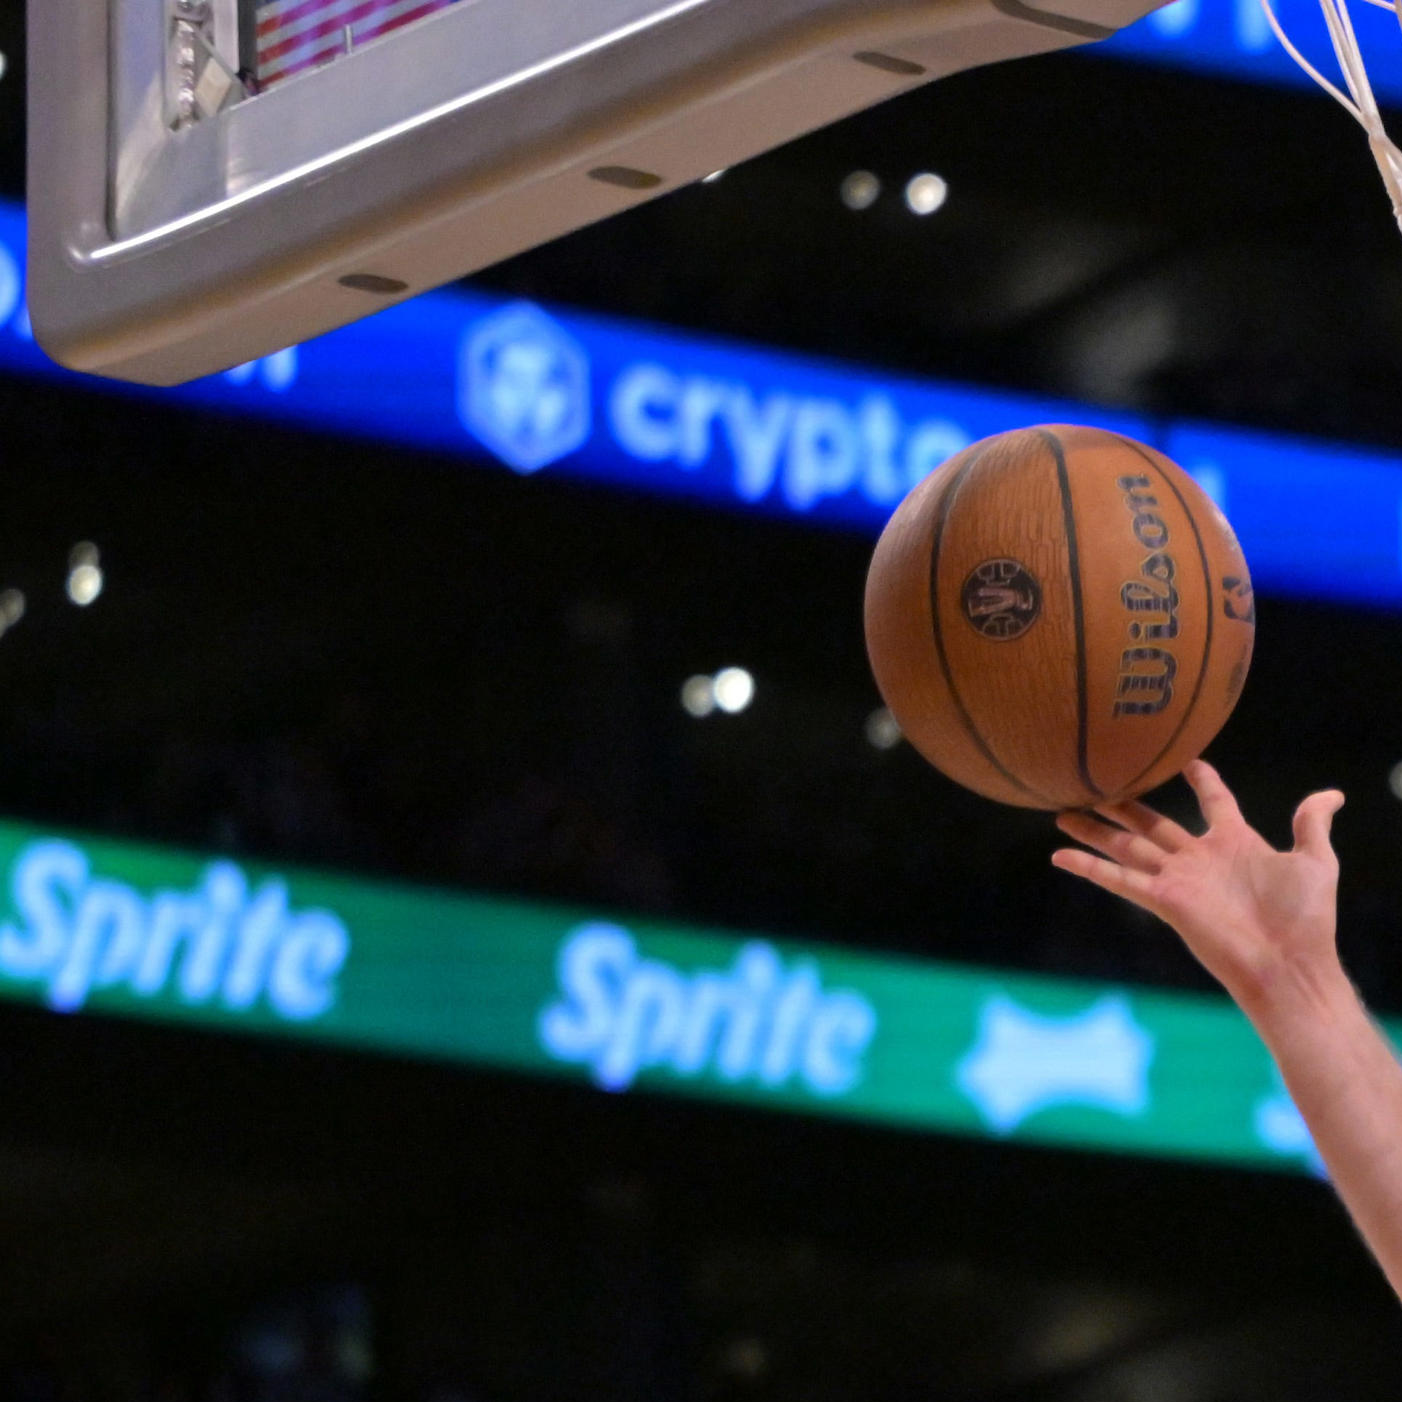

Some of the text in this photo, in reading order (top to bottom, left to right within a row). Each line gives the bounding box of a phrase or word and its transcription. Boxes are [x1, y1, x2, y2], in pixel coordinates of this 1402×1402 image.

[1111, 472, 1181, 721] Wilson
[0, 838, 349, 1013] Sprite
[538, 920, 877, 1094] Sprite
